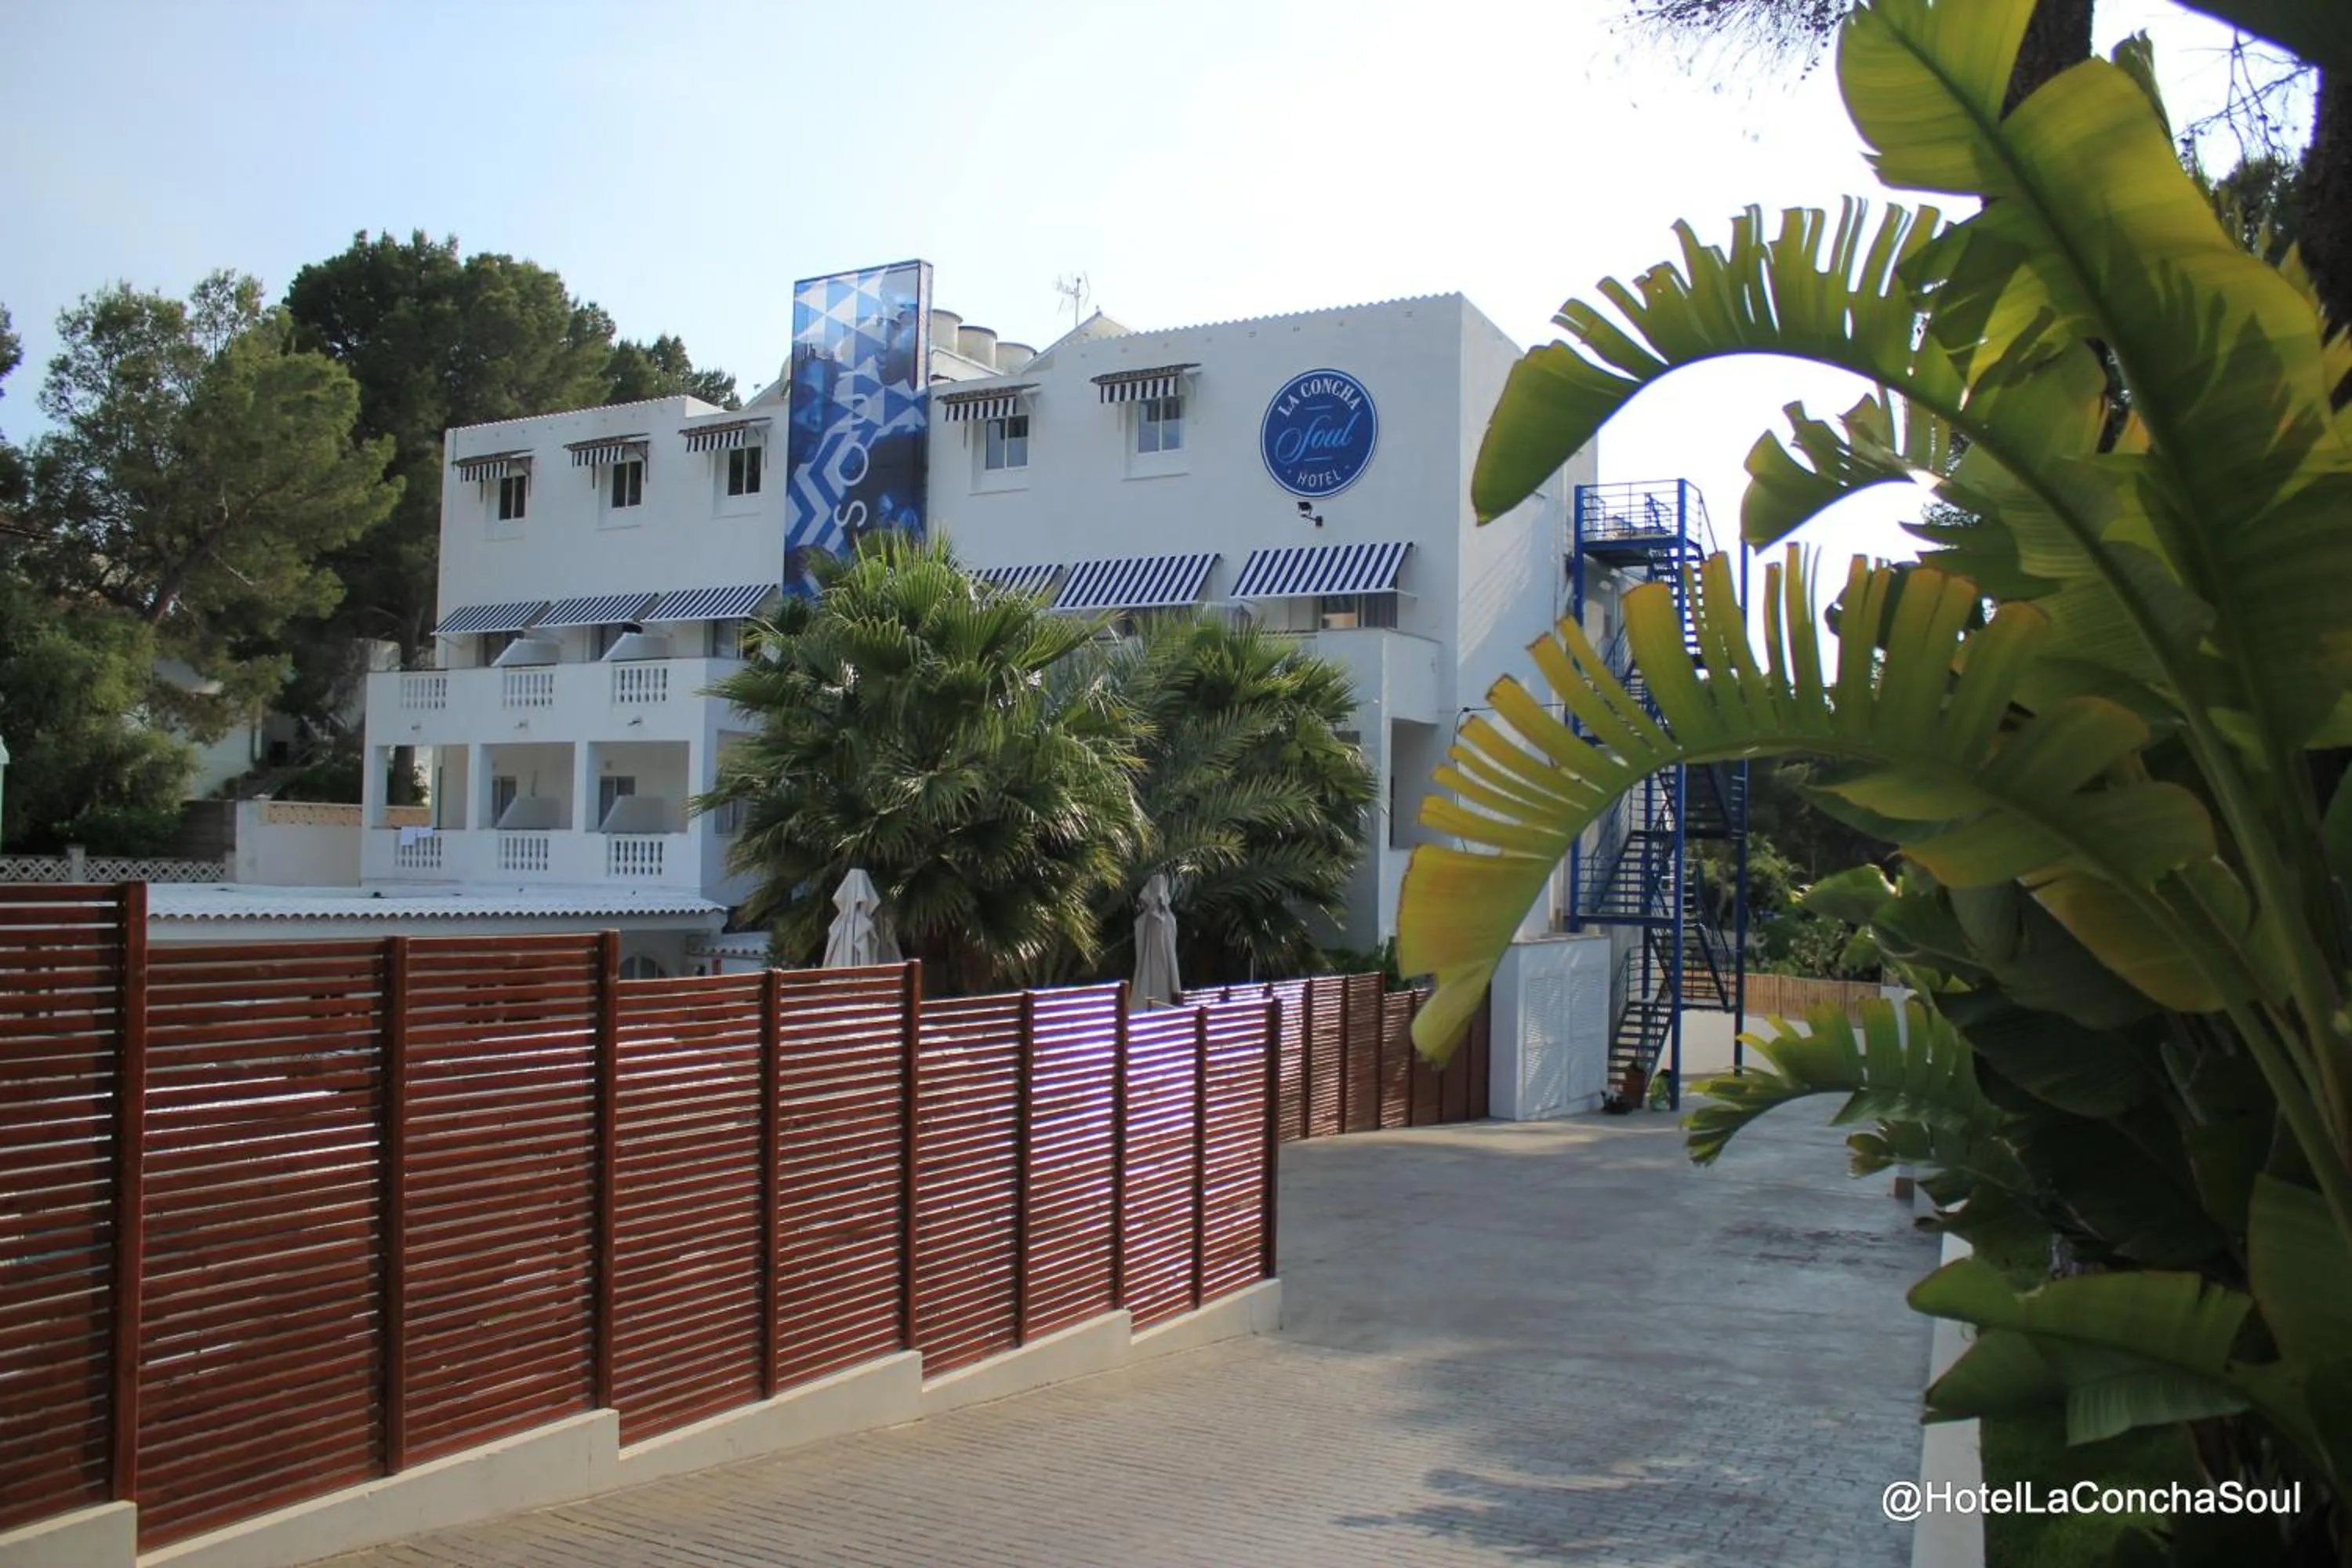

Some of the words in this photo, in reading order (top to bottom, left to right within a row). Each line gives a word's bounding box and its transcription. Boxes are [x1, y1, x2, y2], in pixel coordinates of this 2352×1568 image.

[1277, 393, 1300, 416] LA
[1300, 378, 1361, 410] CONCHA
[1275, 412, 1361, 464] Soul
[1296, 469, 1341, 488] HOTEL
